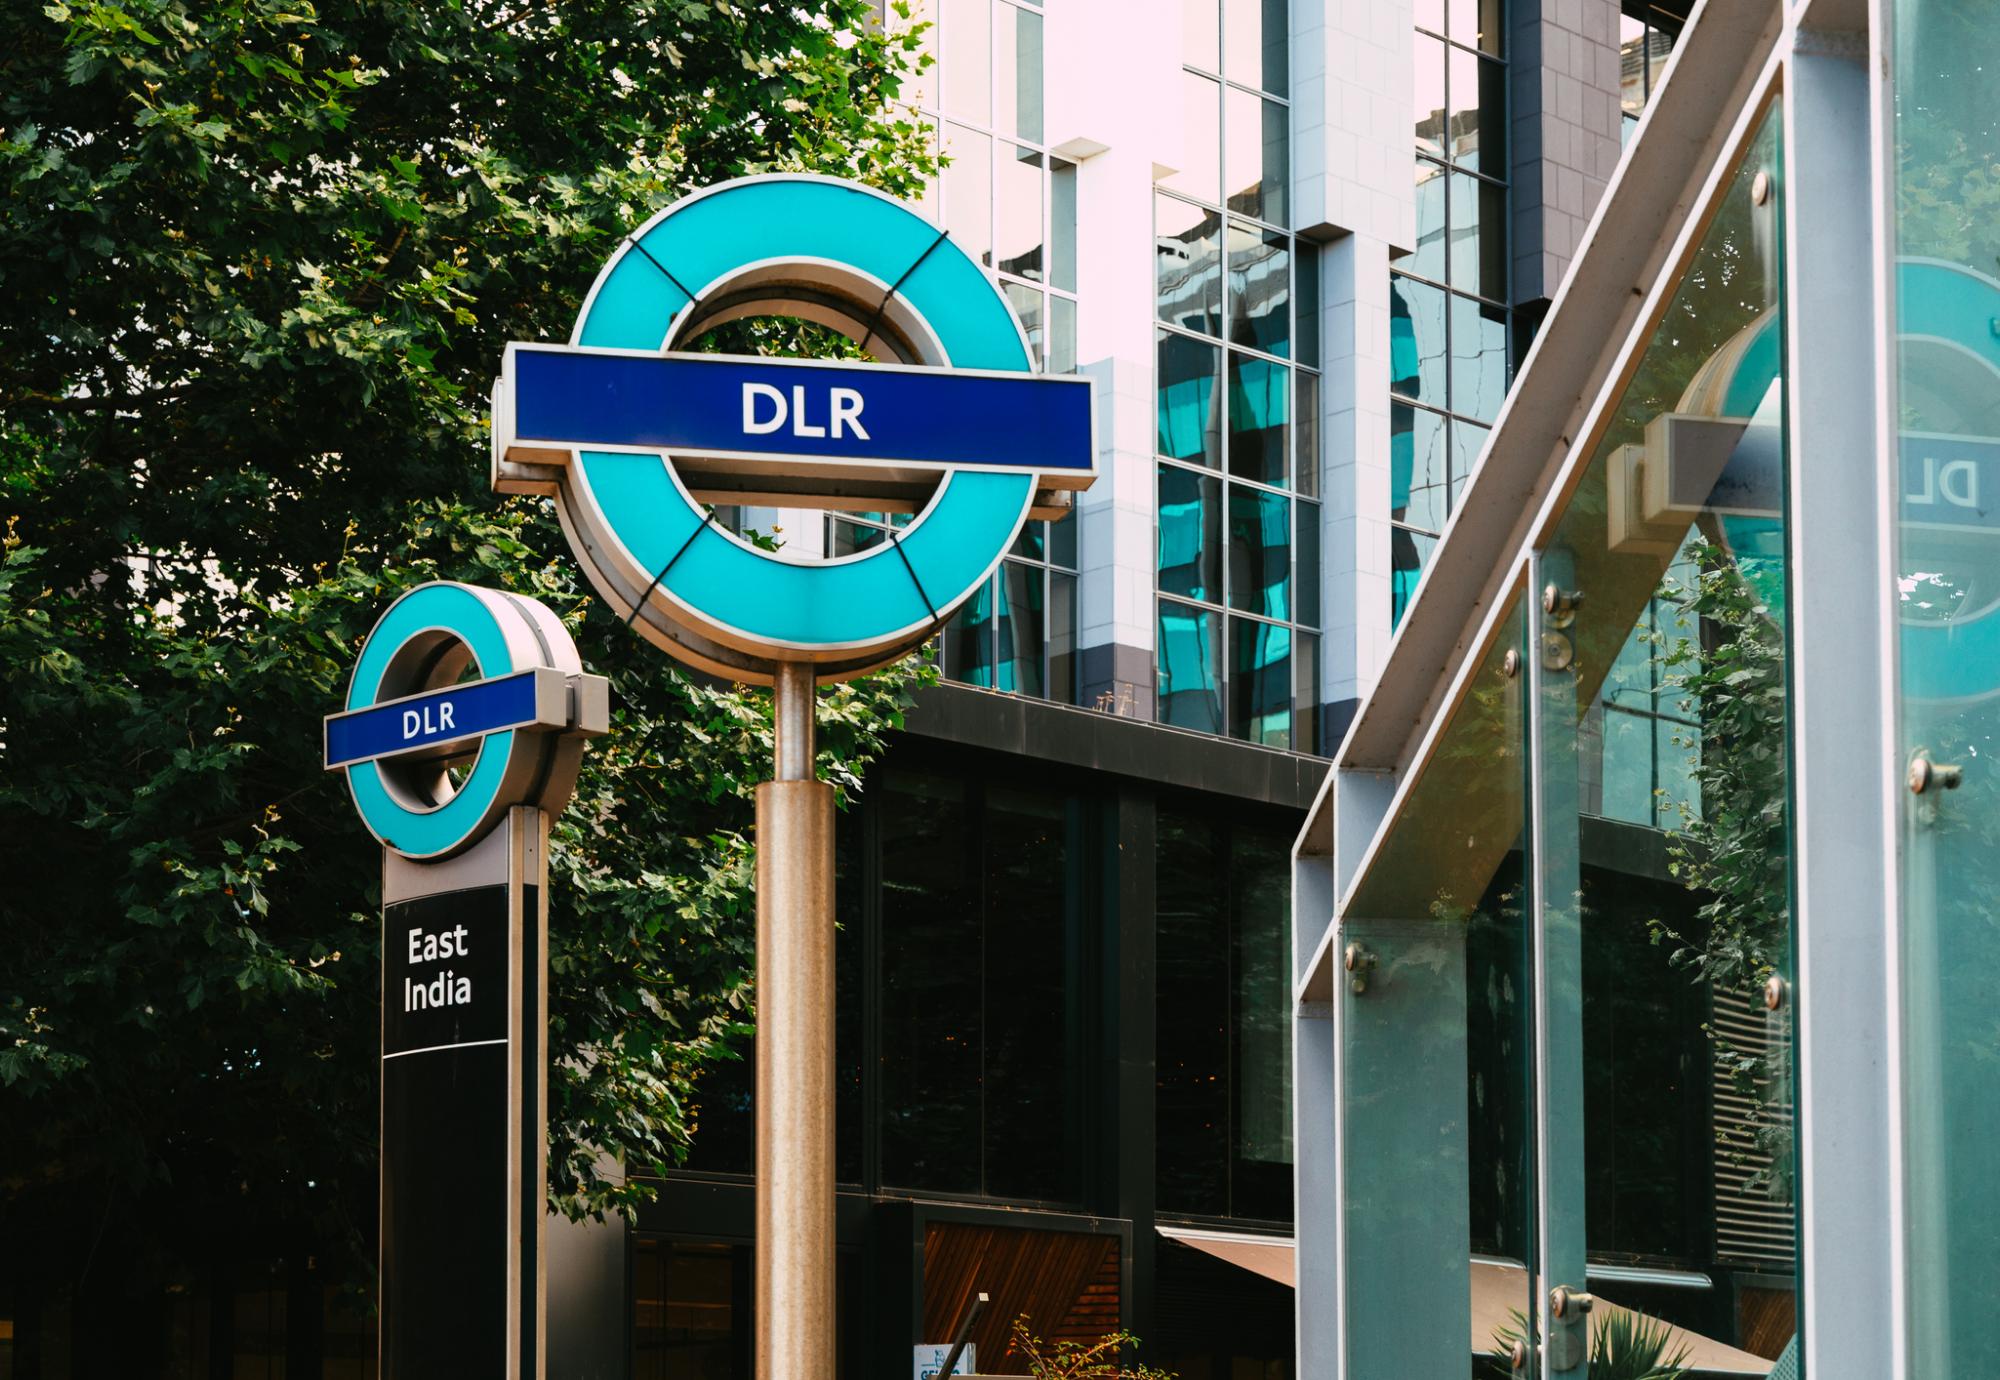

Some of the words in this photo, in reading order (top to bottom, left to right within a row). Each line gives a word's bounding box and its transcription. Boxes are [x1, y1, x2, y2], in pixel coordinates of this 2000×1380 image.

[742, 382, 871, 441] DLR
[402, 702, 456, 740] DLR
[408, 924, 469, 965] East
[404, 970, 472, 1013] India
